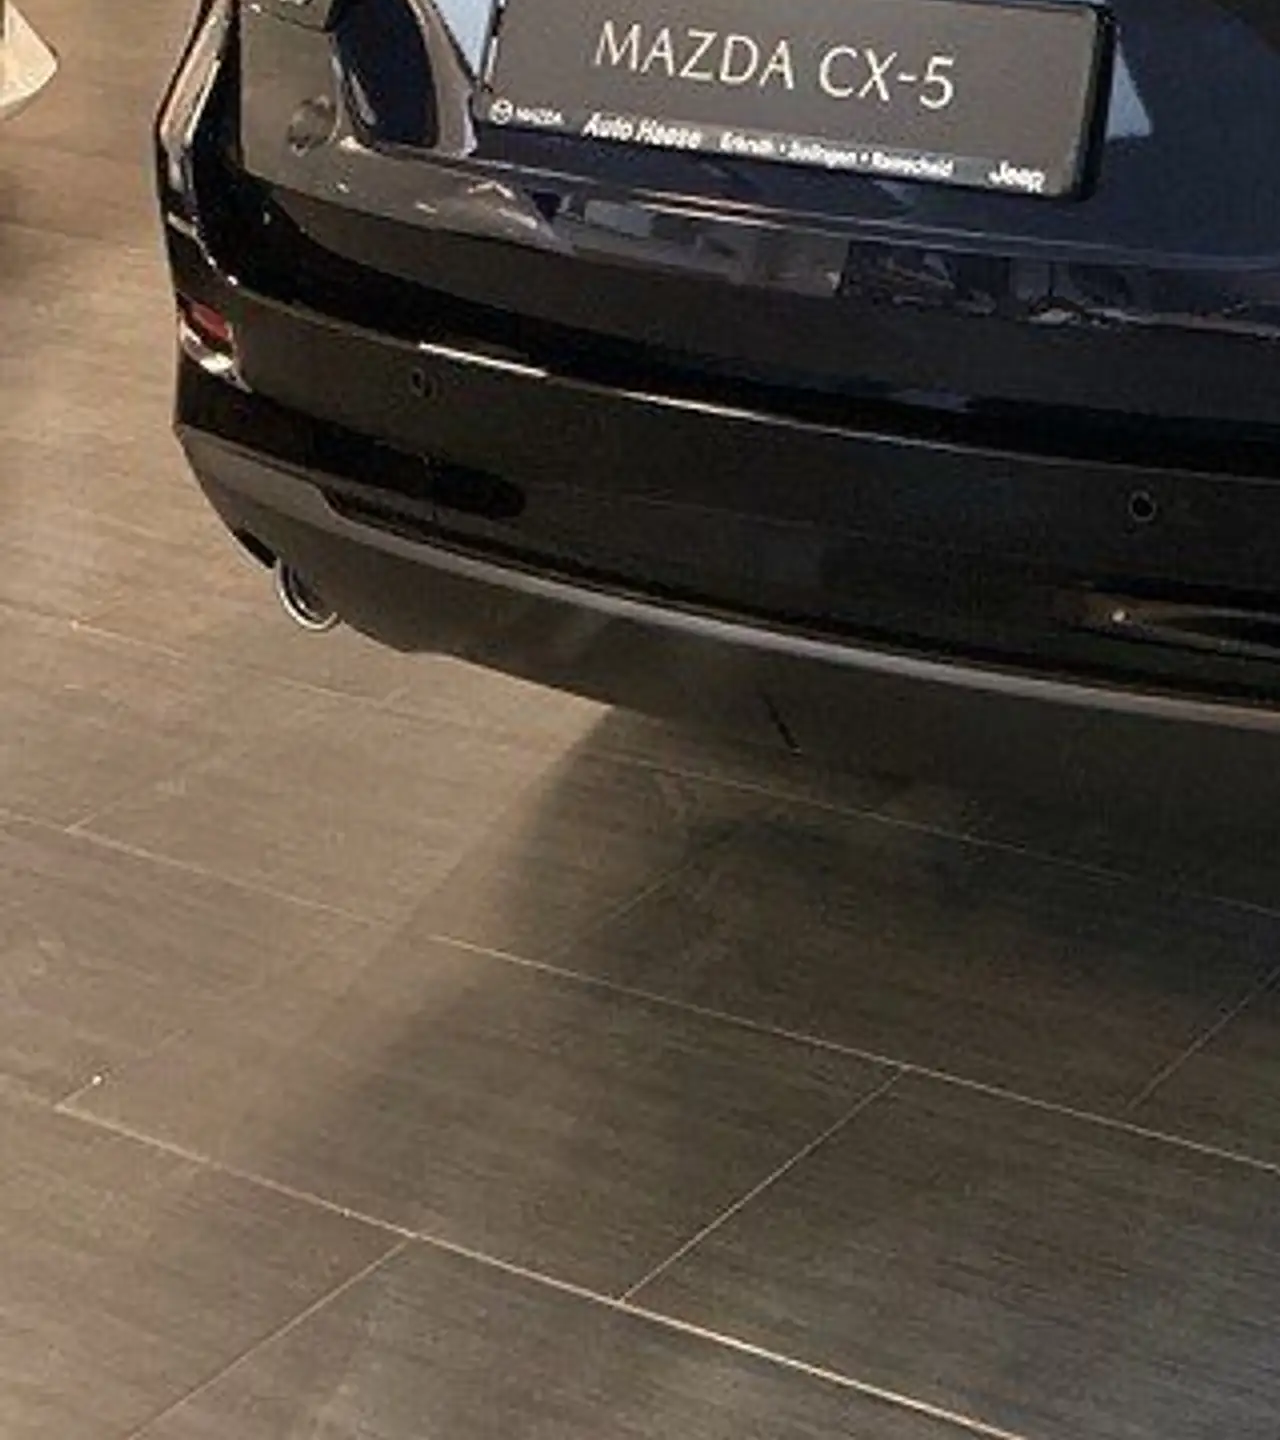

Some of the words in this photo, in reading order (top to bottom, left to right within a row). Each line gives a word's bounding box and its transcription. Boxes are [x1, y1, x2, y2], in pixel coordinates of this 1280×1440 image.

[594, 19, 795, 91] MAZDA
[818, 44, 955, 110] CX-5
[581, 111, 634, 141] Auto
[988, 160, 1046, 194] Jeep
